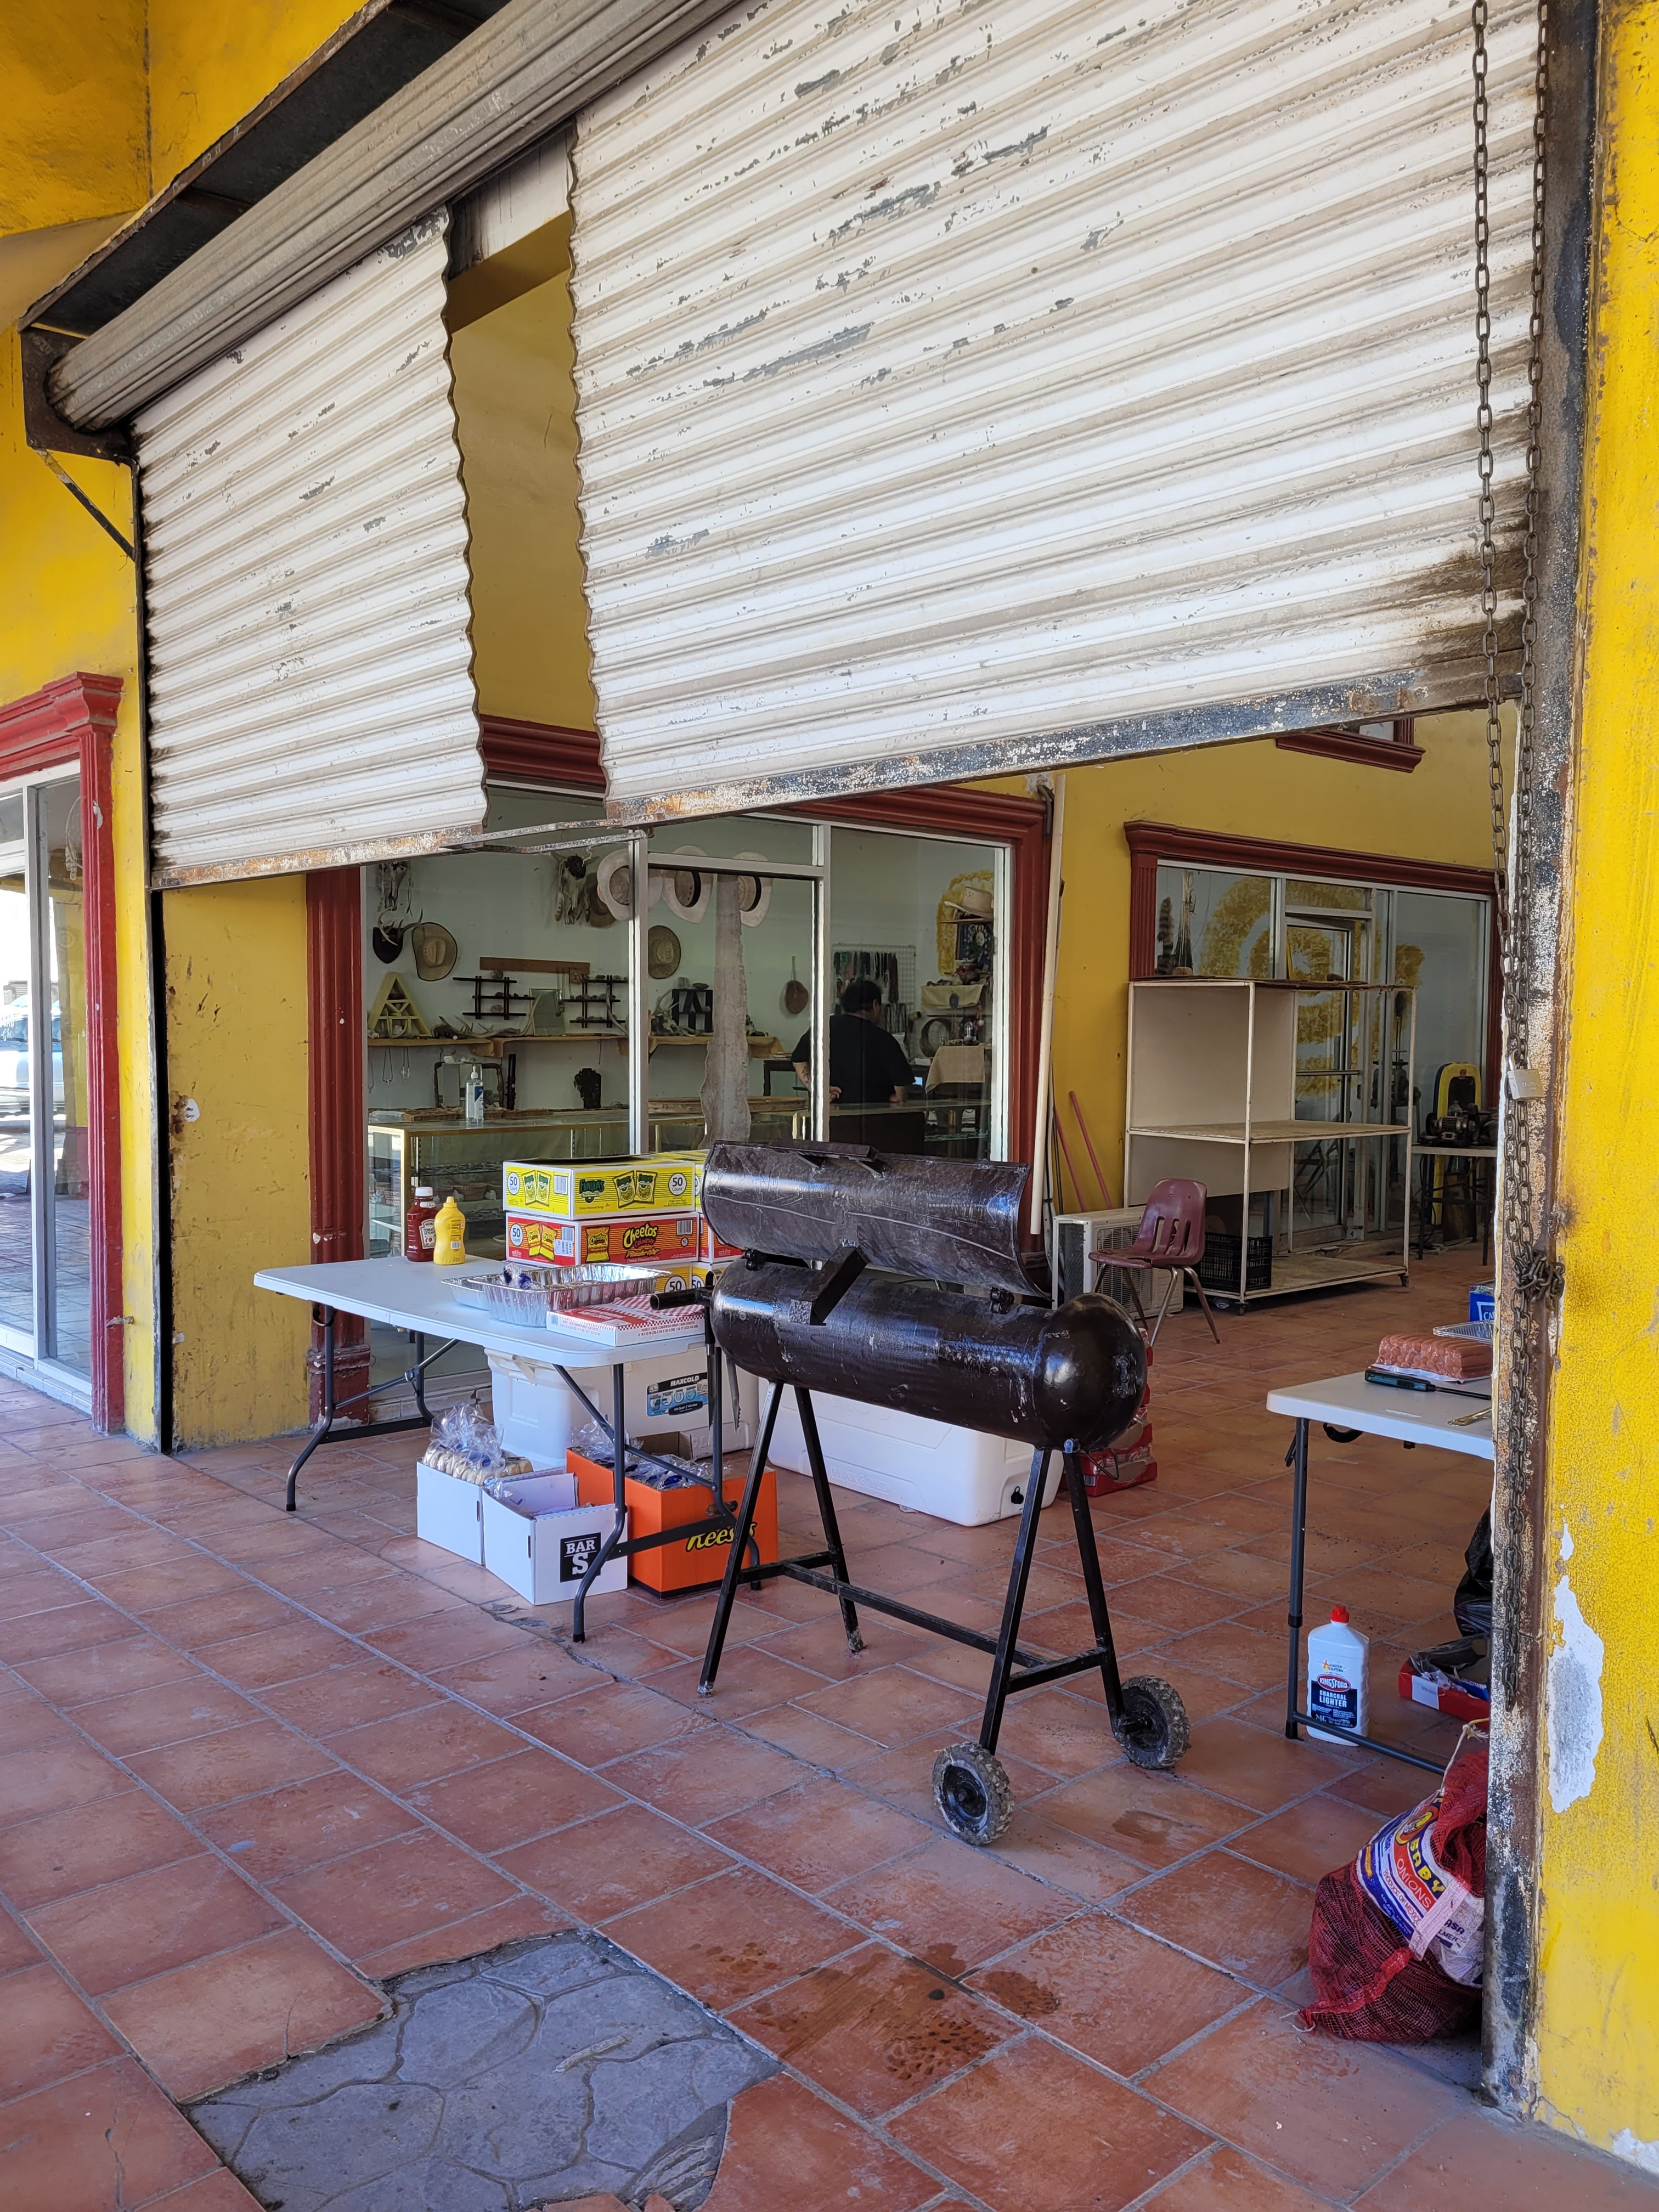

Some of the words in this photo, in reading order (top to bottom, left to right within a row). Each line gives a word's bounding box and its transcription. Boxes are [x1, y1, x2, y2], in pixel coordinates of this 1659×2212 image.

[510, 1176, 517, 1186] 50
[580, 1180, 605, 1193] FUNYUNS
[672, 1177, 682, 1187] 50
[512, 1227, 521, 1237] 50
[624, 1223, 658, 1248] Cheetos
[635, 1238, 656, 1248] CRUNCHY
[669, 1280, 682, 1292] 50
[670, 1375, 699, 1387] MAXCOLD
[566, 1539, 596, 1555] BAR
[572, 1552, 589, 1576] S
[1319, 1677, 1348, 1689] KINGSFORD
[1319, 1690, 1346, 1700] CHARCOAL
[1319, 1695, 1347, 1708] LIGHTER
[1410, 1837, 1446, 1892] BABY
[1383, 1869, 1400, 1897] PRODUCE
[1399, 1895, 1407, 1903] OF
[1397, 1858, 1432, 1909] ONIONS
[1444, 1919, 1465, 1935] ASA
[1438, 1929, 1458, 1942] LMER
